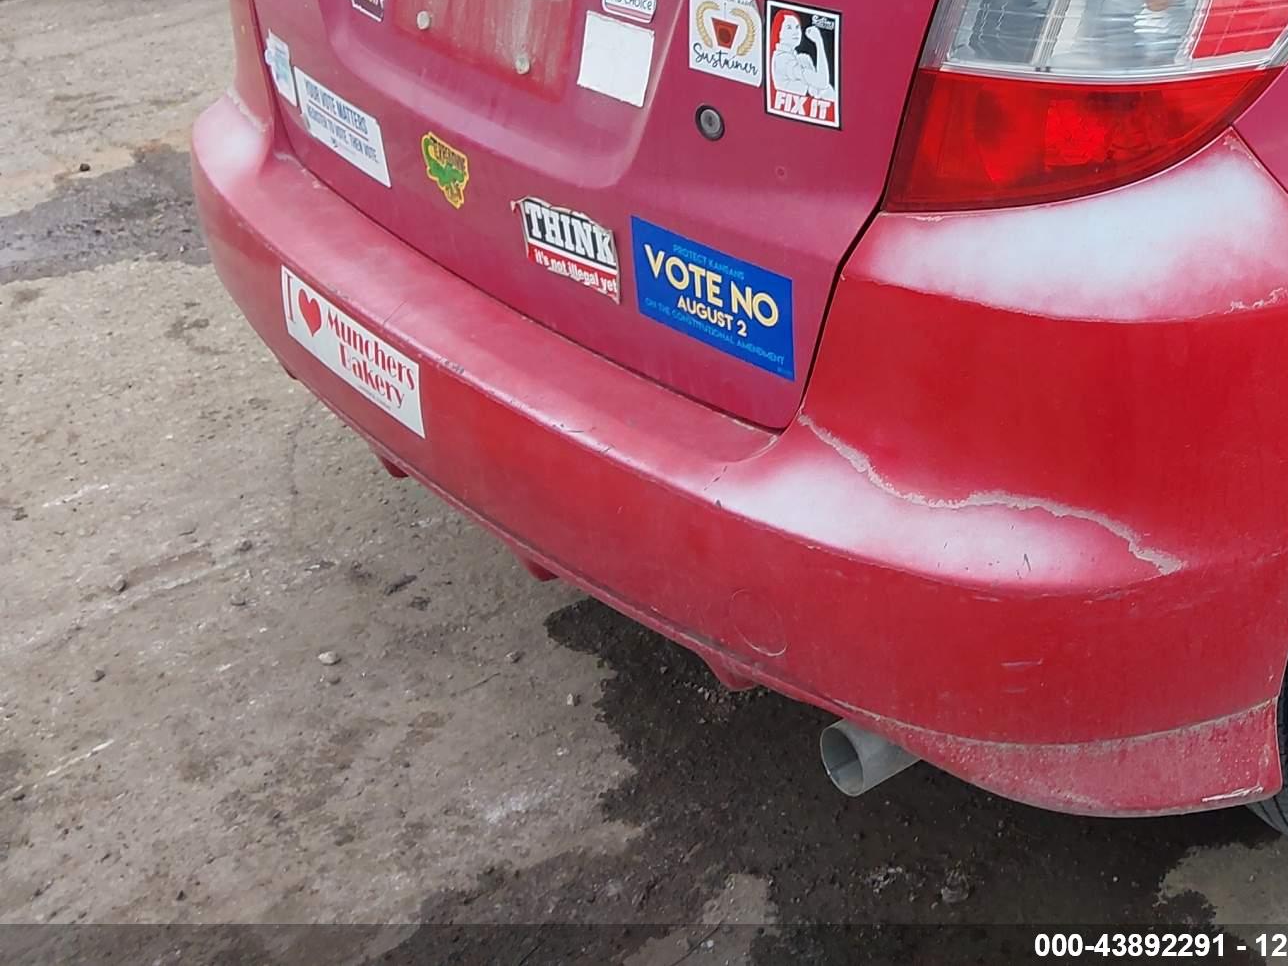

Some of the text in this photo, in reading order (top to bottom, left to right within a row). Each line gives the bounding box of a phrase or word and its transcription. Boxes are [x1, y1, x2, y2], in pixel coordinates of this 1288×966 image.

[692, 42, 759, 76] Sustainer
[321, 88, 337, 115] VOTE
[337, 99, 368, 135] MATTERS
[774, 91, 831, 120] FIX IT
[524, 201, 616, 265] THINK
[550, 259, 568, 277] not
[568, 262, 600, 287] illegal
[600, 277, 618, 294] yet
[673, 244, 745, 281] PROTECT KANSANS
[644, 243, 779, 327] VOTE NO
[677, 295, 747, 338] AUGUST 2
[327, 309, 415, 391] Munchers
[736, 340, 785, 366] AMENDMENT
[339, 342, 405, 410] Bakery
